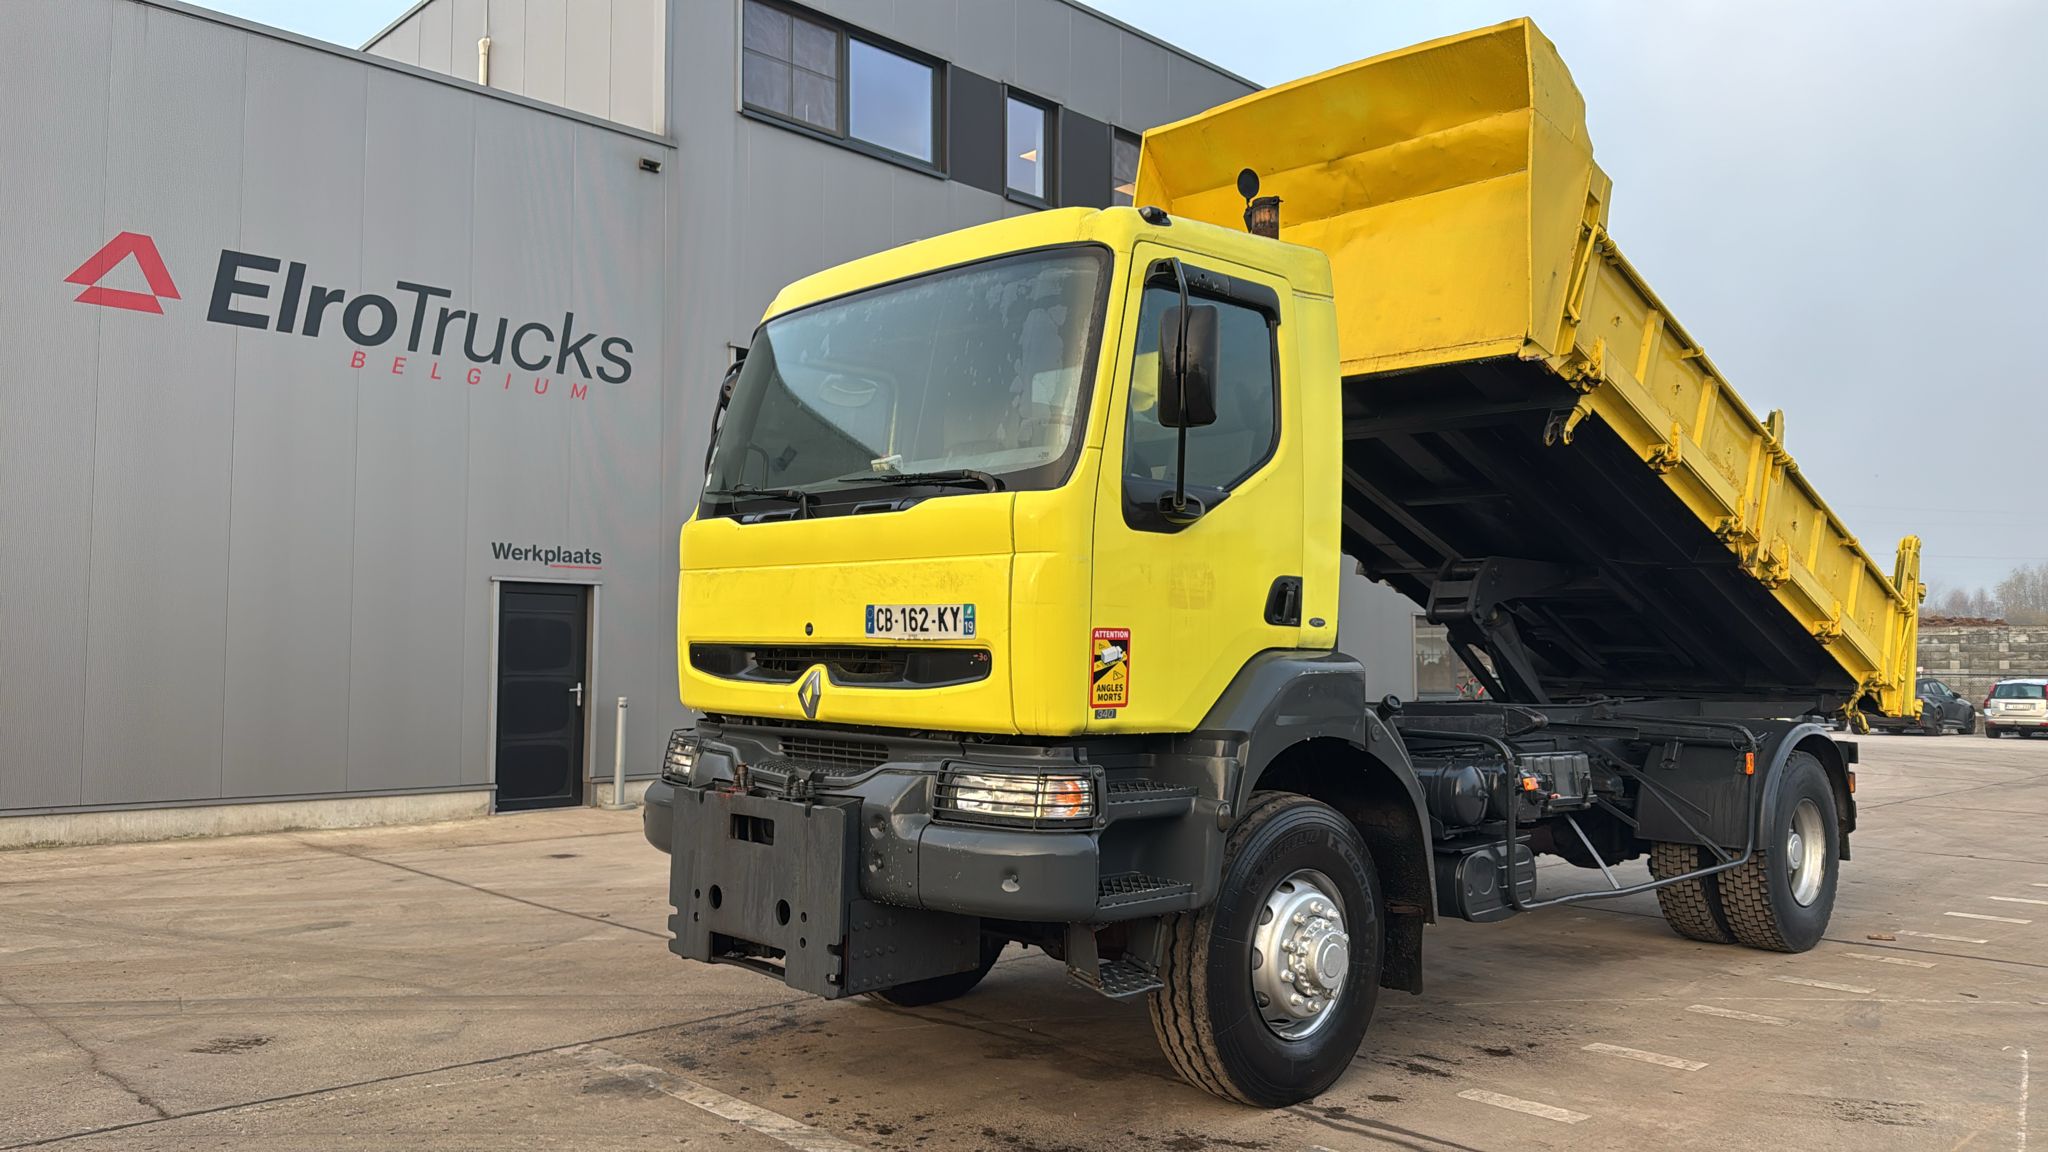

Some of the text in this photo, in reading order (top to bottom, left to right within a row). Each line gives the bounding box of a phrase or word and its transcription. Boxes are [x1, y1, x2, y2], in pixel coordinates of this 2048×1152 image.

[207, 249, 634, 385] ElroTrucks
[350, 350, 588, 400] BELGIUM
[491, 541, 602, 565] Werkplaats
[876, 607, 960, 632] CB-162-KY
[964, 621, 973, 633] 19
[1094, 630, 1129, 638] ATTENTION
[1096, 684, 1123, 692] ANGLES
[1097, 693, 1122, 701] MORTS
[1096, 709, 1114, 719] 340
